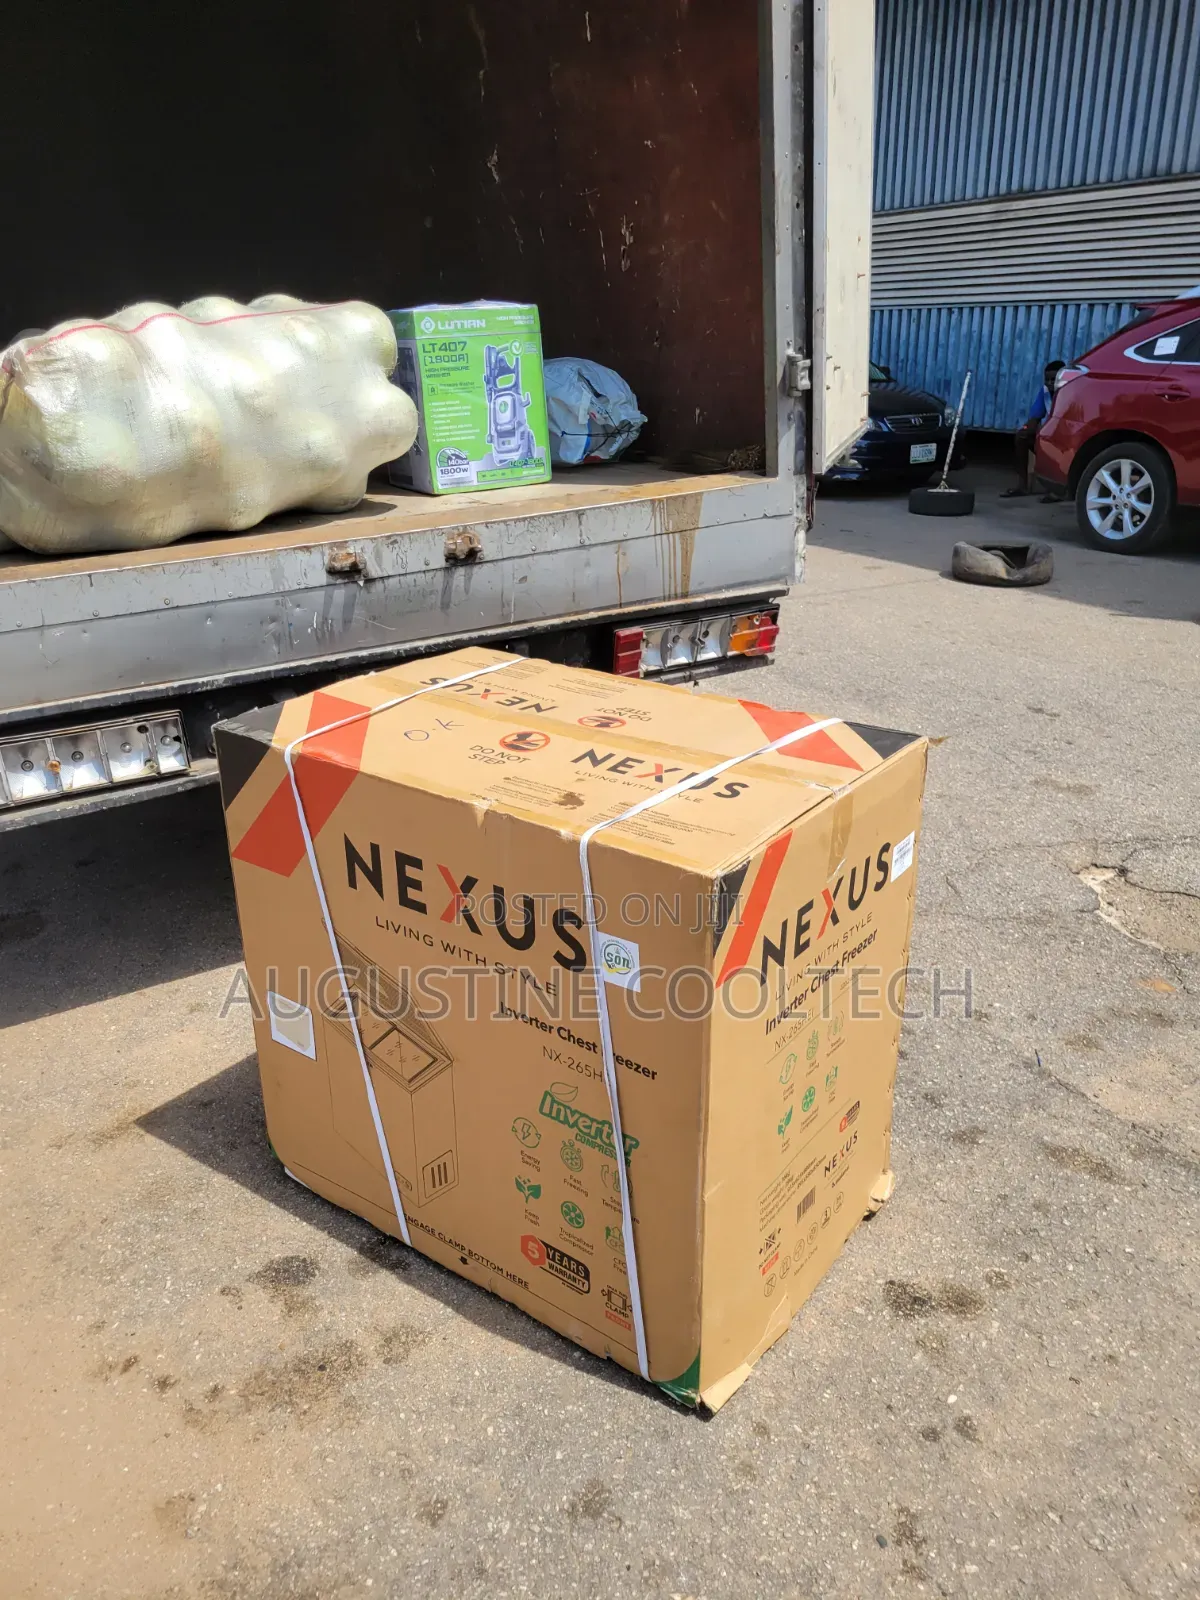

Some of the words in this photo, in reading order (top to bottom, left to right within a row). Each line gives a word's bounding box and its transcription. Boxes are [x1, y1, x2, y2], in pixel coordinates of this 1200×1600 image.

[438, 318, 486, 331] LUTIAN
[422, 341, 467, 354] LT407
[594, 707, 625, 716] NOT
[615, 706, 651, 715] STEP
[629, 714, 652, 722] DO
[468, 753, 507, 766] STEP
[469, 745, 491, 754] DO
[497, 751, 531, 764] NOT
[574, 771, 617, 784] LIVING
[622, 780, 659, 792] WITH
[343, 832, 587, 976] NEXUS
[760, 842, 891, 987] NEXUS
[375, 914, 433, 948] LIVING
[441, 938, 486, 969] WITH
[494, 960, 557, 997] STYLE
[775, 961, 810, 1002] LIVING
[814, 936, 839, 969] WITH
[842, 909, 872, 945] STYLE
[765, 983, 808, 1037] Inverter
[810, 955, 839, 997] Chest
[841, 924, 877, 969] Freezer
[500, 1001, 554, 1035] Inverter
[557, 1024, 597, 1054] Chest
[520, 1149, 540, 1166] Energy
[824, 1130, 858, 1177] NEXUS
[521, 1156, 540, 1172] Saving
[563, 1177, 588, 1197] Freezing
[569, 1173, 581, 1185] Fast
[524, 1208, 539, 1222] Keep
[524, 1214, 539, 1227] Fresh
[559, 1226, 593, 1251] Tropicalized
[559, 1232, 594, 1258] Compressor
[527, 1239, 540, 1261] 5
[437, 1231, 465, 1253] CLAMP
[468, 1248, 503, 1275] BOTTOM
[506, 1270, 529, 1290] HERE
[547, 1248, 584, 1277] YEARS
[548, 1261, 585, 1289] WARRANTY
[605, 1301, 628, 1320] CLAMP
